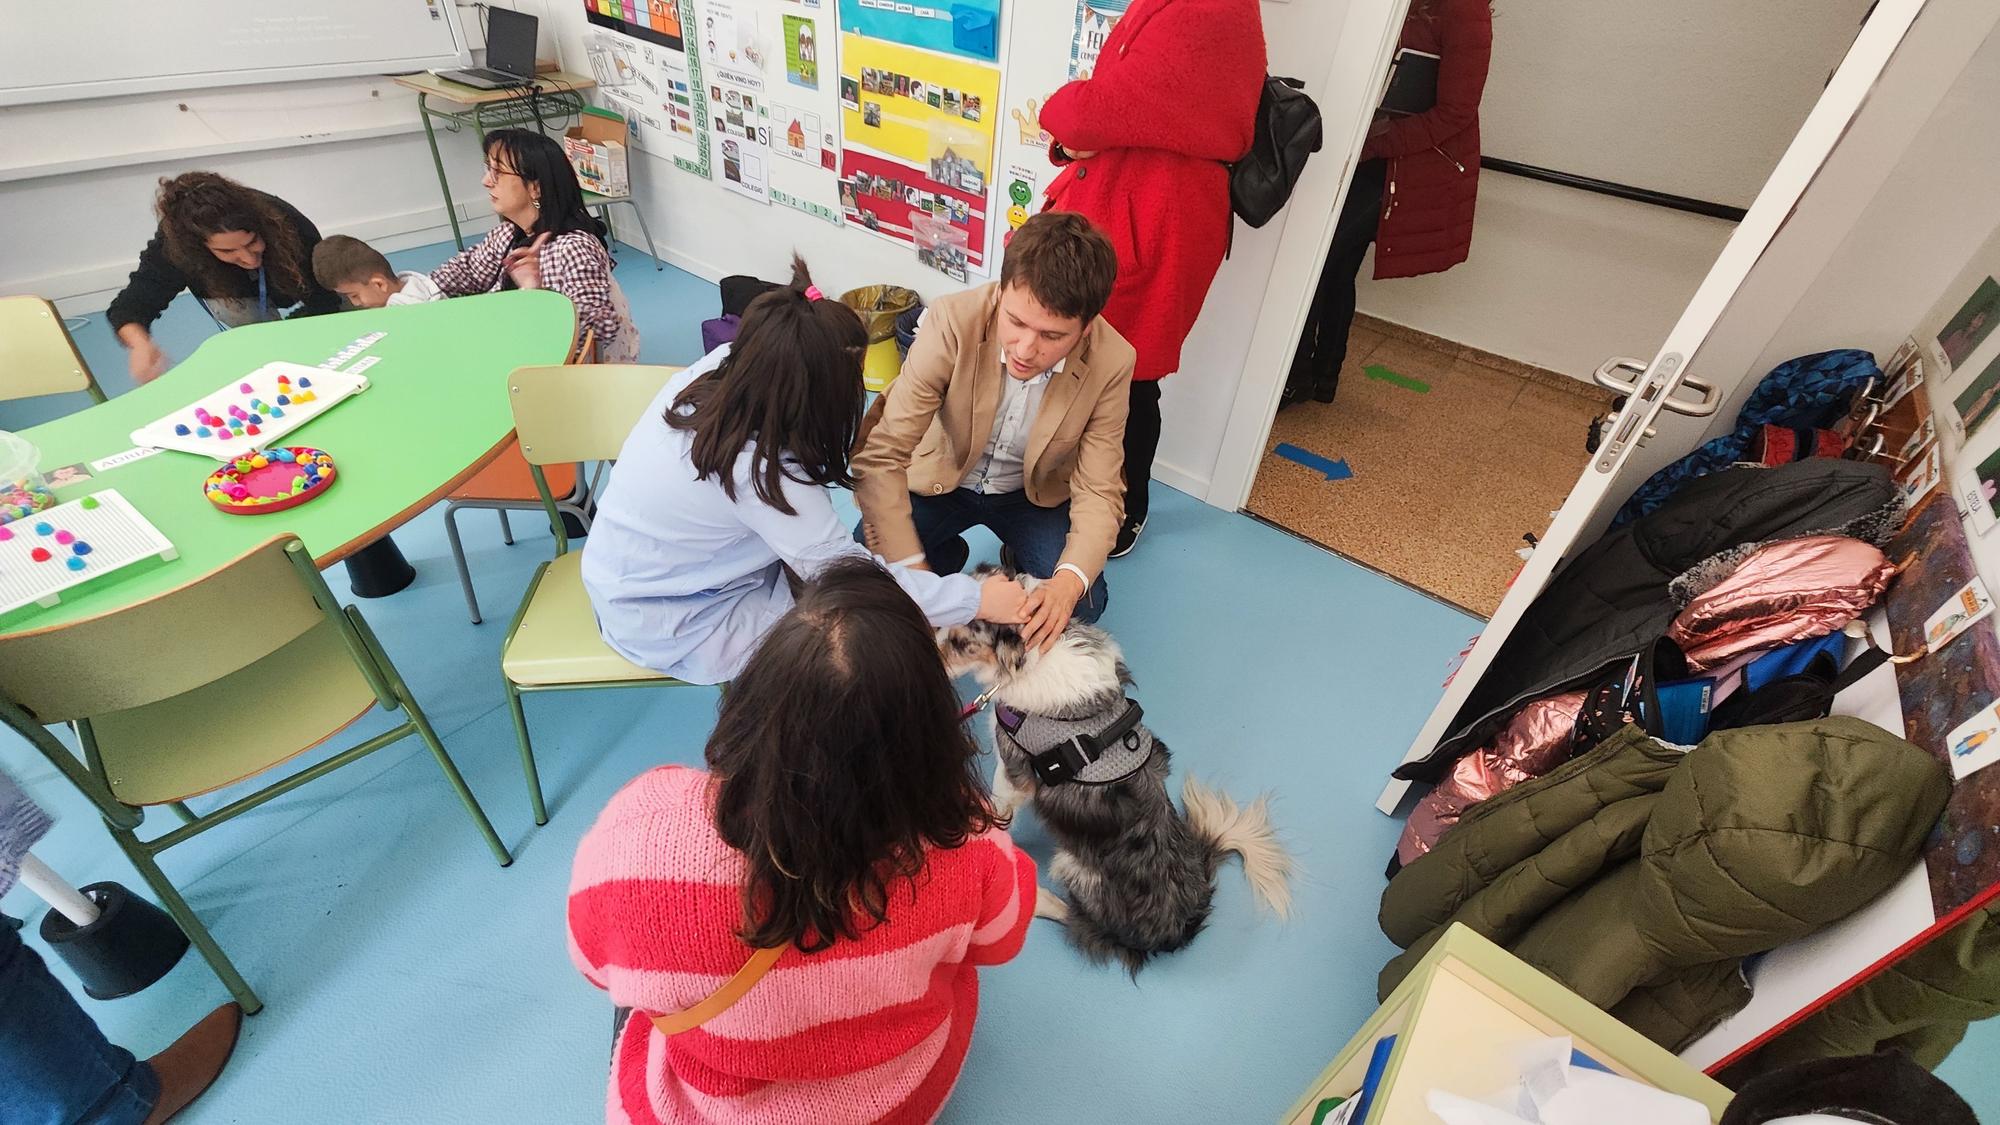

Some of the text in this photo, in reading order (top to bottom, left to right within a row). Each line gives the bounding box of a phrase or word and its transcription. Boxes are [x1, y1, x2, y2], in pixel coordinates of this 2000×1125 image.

[684, 16, 693, 26] 12
[685, 27, 694, 37] 13
[686, 38, 695, 48] 14
[688, 47, 696, 57] 15
[689, 58, 697, 68] 16
[691, 69, 699, 79] 17
[692, 80, 701, 90] 18
[697, 119, 706, 128] 22
[758, 126, 773, 148] SÍ
[822, 152, 836, 168] NO
[741, 180, 763, 195] COLEGIO
[101, 447, 154, 468] ADRIA
[1966, 488, 1982, 514] ESTELA
